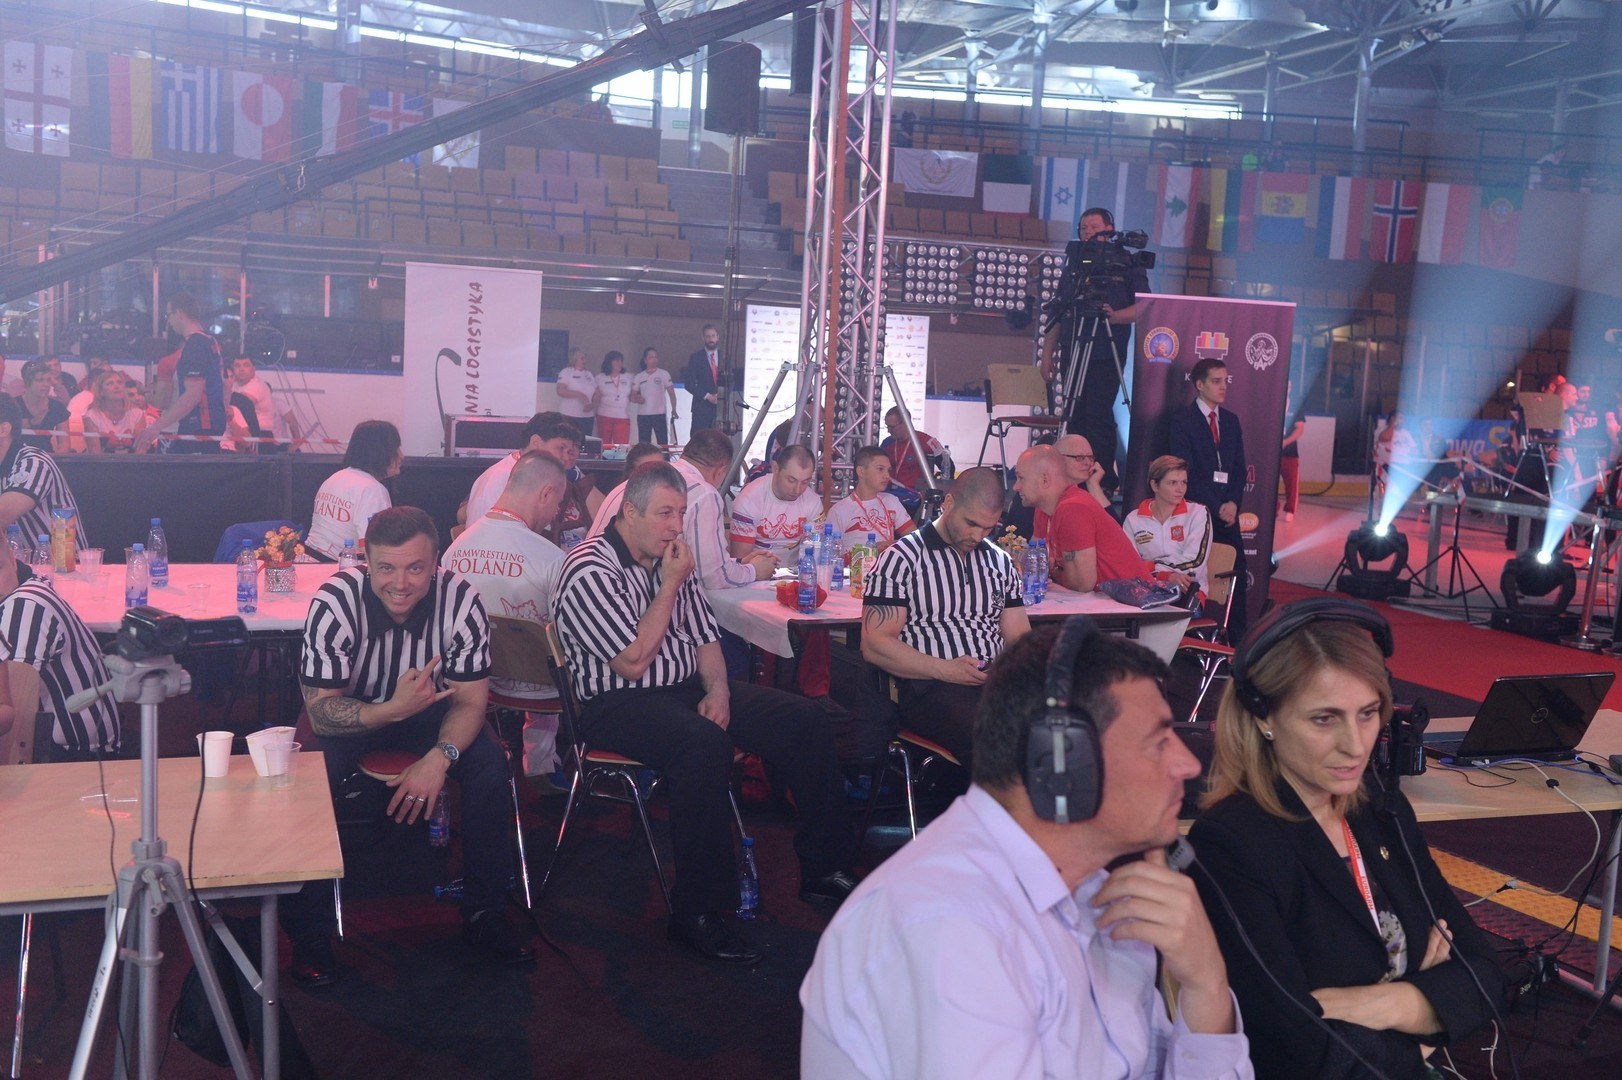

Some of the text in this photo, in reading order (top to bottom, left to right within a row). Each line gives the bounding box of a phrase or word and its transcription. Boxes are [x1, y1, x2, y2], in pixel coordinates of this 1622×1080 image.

[466, 281, 484, 379] LOGISTYKA
[452, 548, 525, 564] ARMWRESTLING
[450, 558, 523, 578] POLAND
